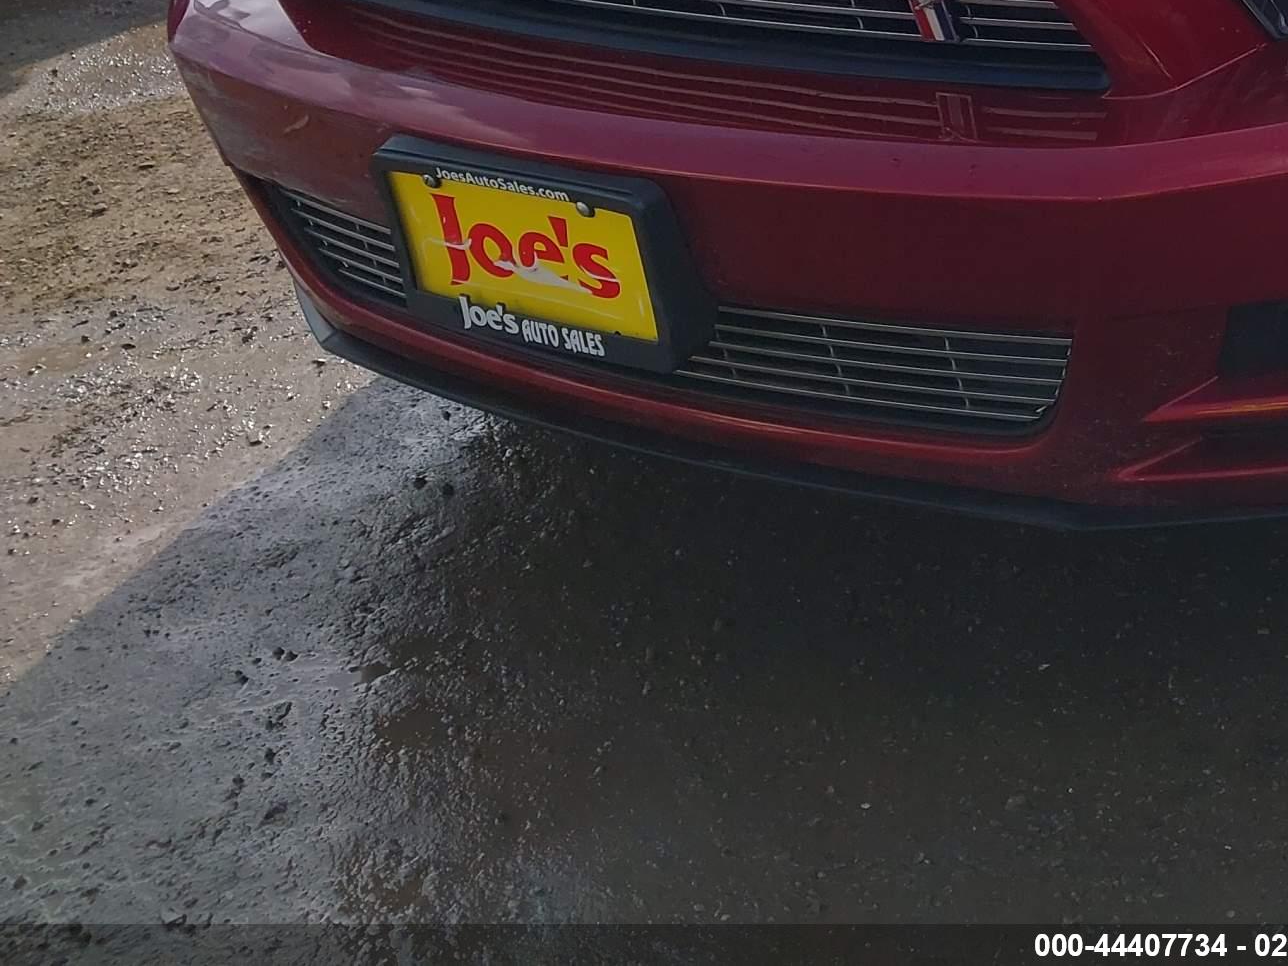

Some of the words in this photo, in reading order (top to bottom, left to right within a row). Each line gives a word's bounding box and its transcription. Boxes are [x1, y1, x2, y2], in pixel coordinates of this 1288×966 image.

[435, 166, 571, 203] JoesAutoSales.com
[429, 192, 622, 300] Joe's
[459, 295, 519, 335] Joe's
[521, 319, 559, 348] AUTO
[562, 328, 606, 357] SALES
